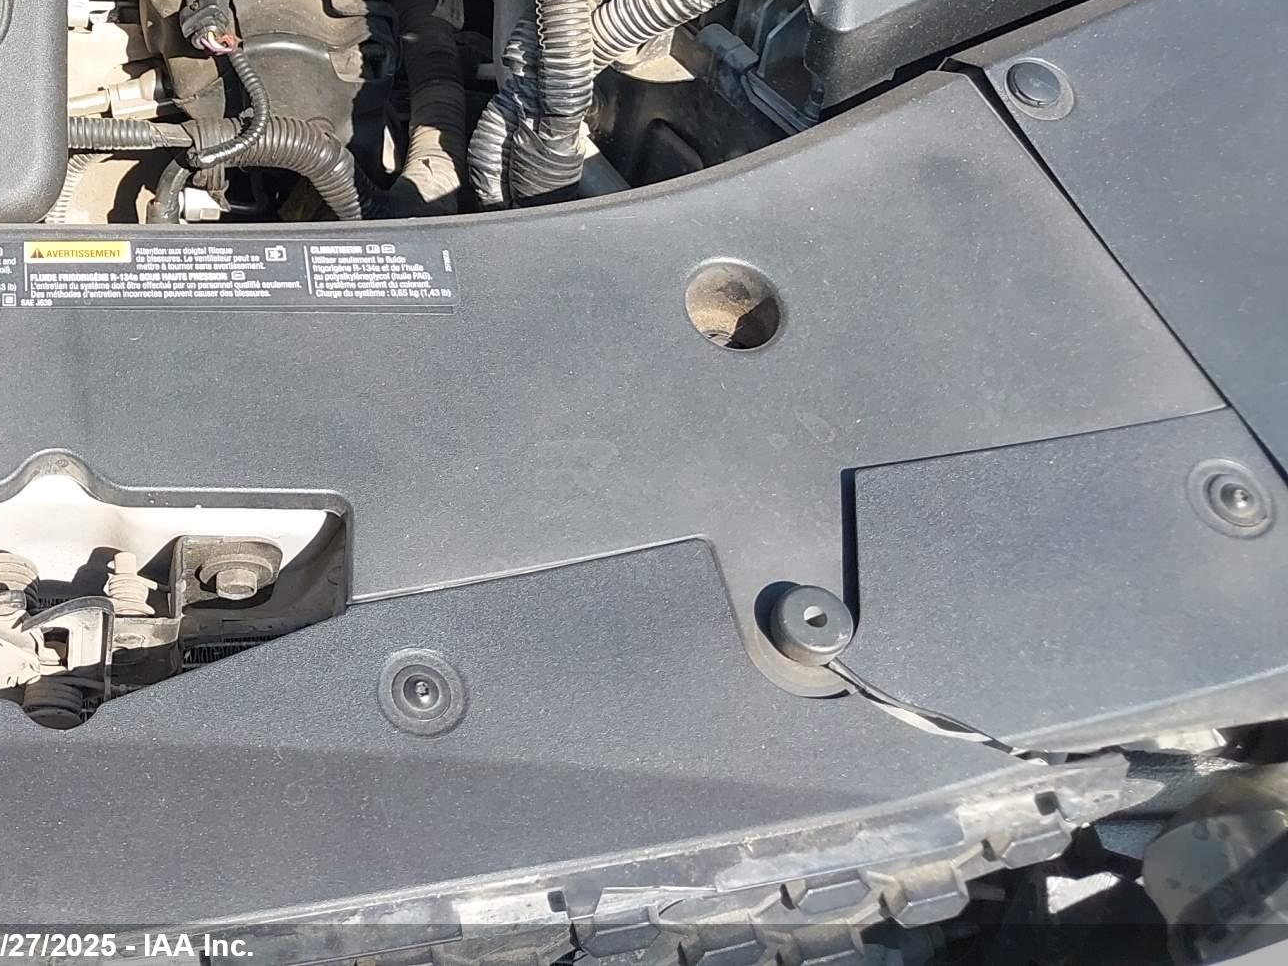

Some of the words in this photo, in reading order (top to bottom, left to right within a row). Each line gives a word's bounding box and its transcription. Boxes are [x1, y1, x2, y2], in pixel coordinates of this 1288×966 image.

[391, 273, 411, 281] (huile
[413, 272, 432, 281] PAG).
[8, 283, 17, 291] lb)
[198, 281, 233, 290] personnel
[164, 290, 192, 298] peuvent
[316, 290, 342, 298] Charge
[409, 289, 419, 297] kg
[441, 289, 451, 297] lb)
